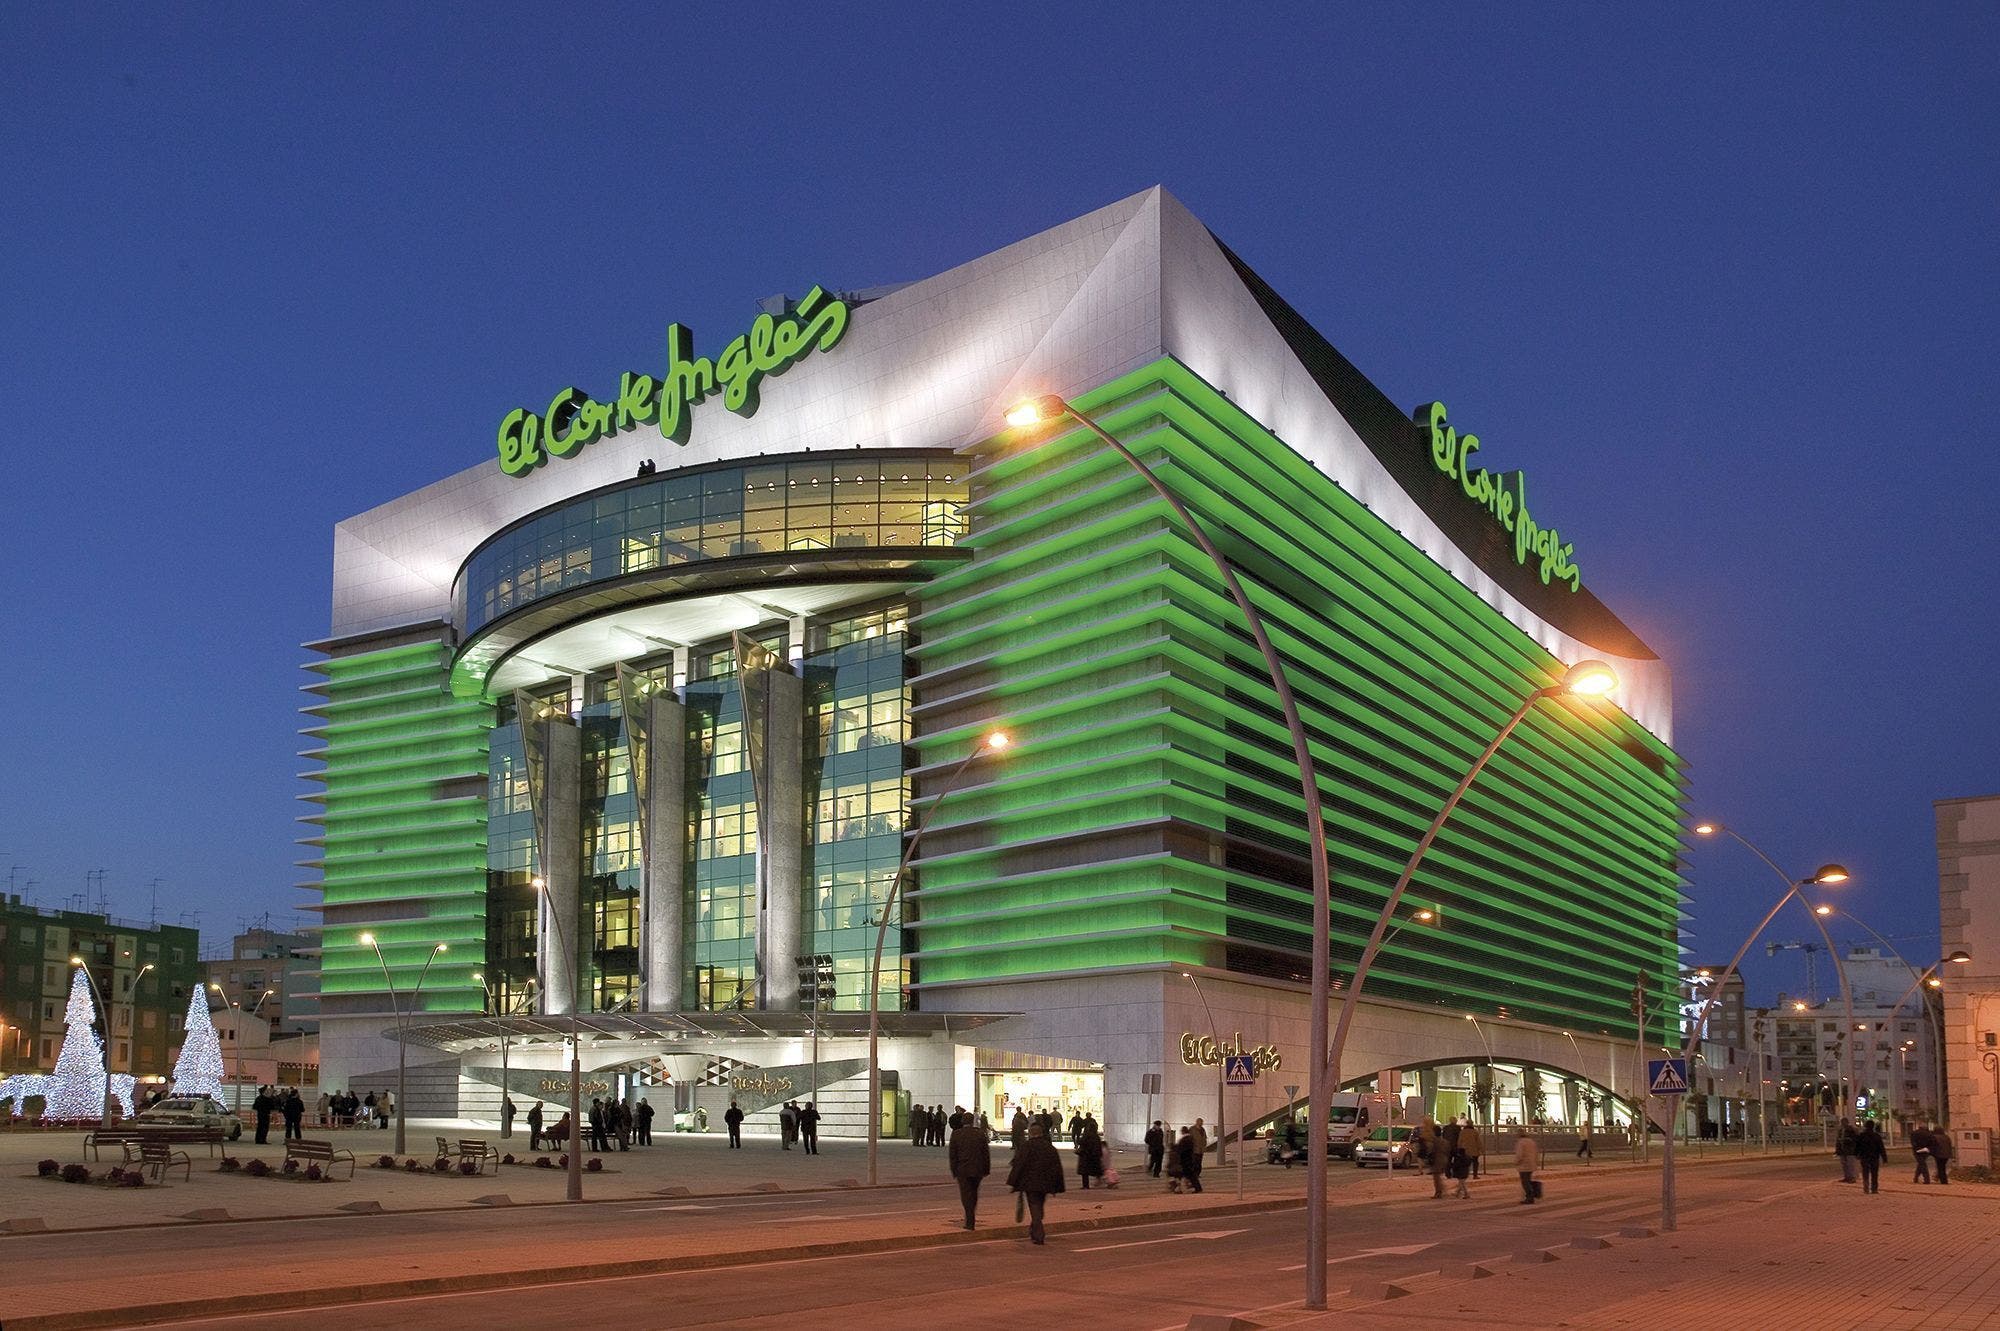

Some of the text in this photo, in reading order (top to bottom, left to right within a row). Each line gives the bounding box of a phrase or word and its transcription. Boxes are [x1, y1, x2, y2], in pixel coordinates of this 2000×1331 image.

[497, 407, 541, 475] El
[543, 371, 654, 456] Corte
[1430, 401, 1457, 480] El
[1459, 434, 1514, 532] Corte
